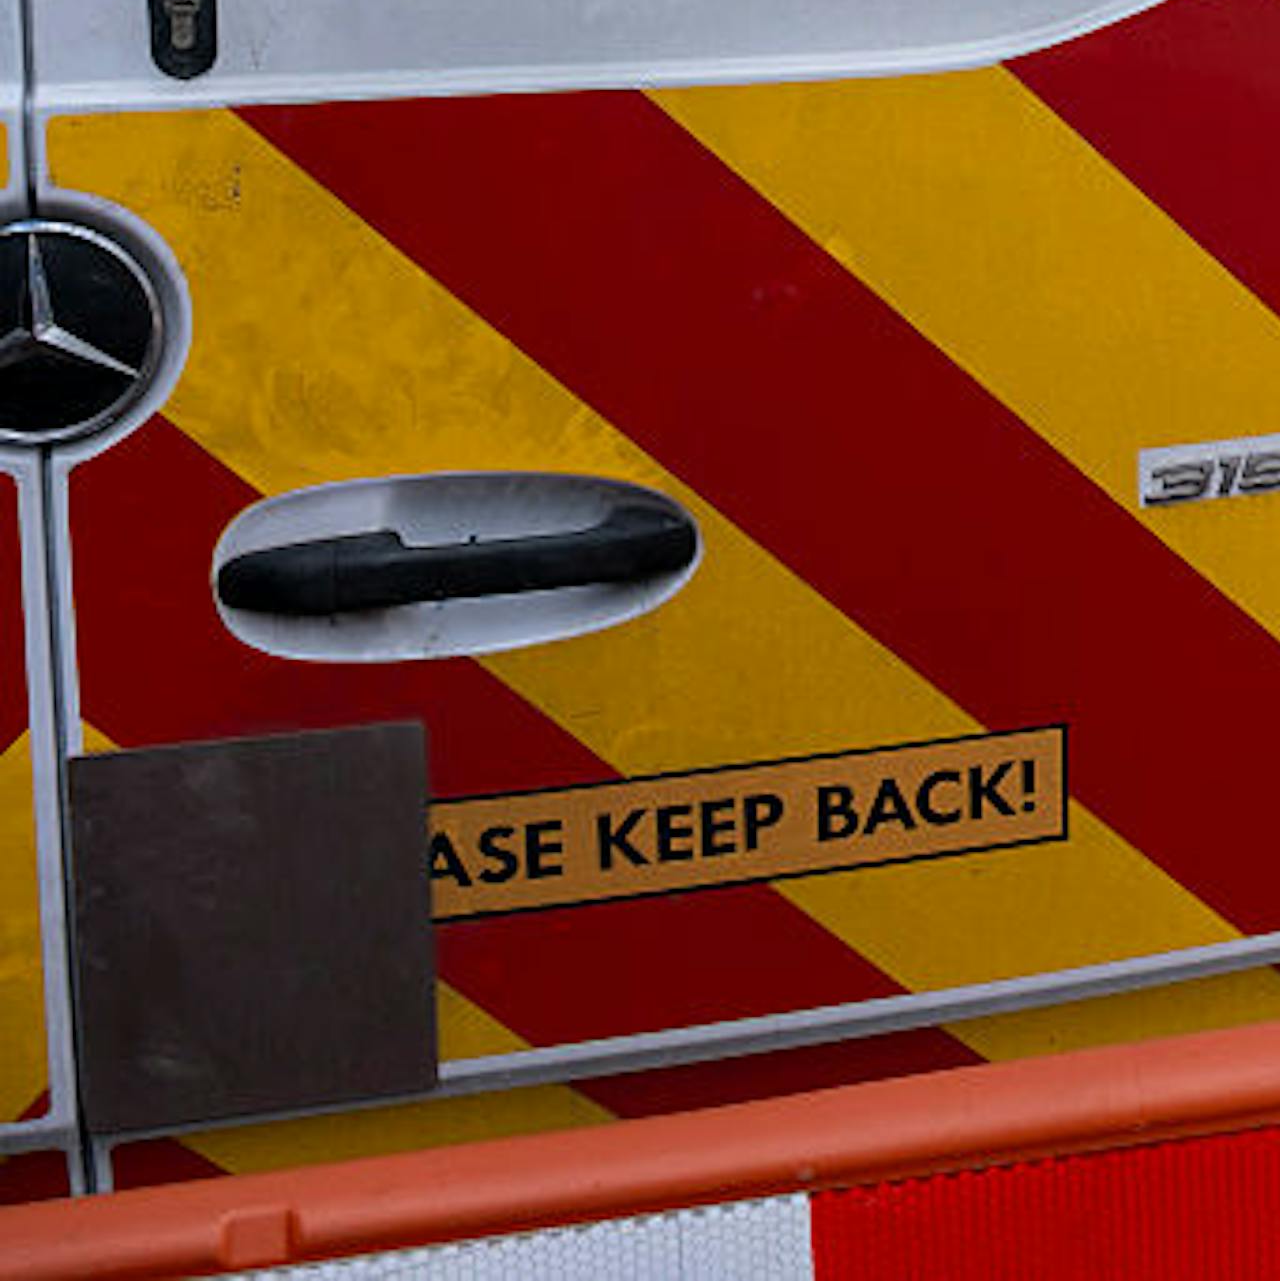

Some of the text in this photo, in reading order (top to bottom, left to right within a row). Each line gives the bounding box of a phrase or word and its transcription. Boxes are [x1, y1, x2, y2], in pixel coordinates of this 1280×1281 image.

[430, 758, 1037, 887] ASE KEEP BACK!
